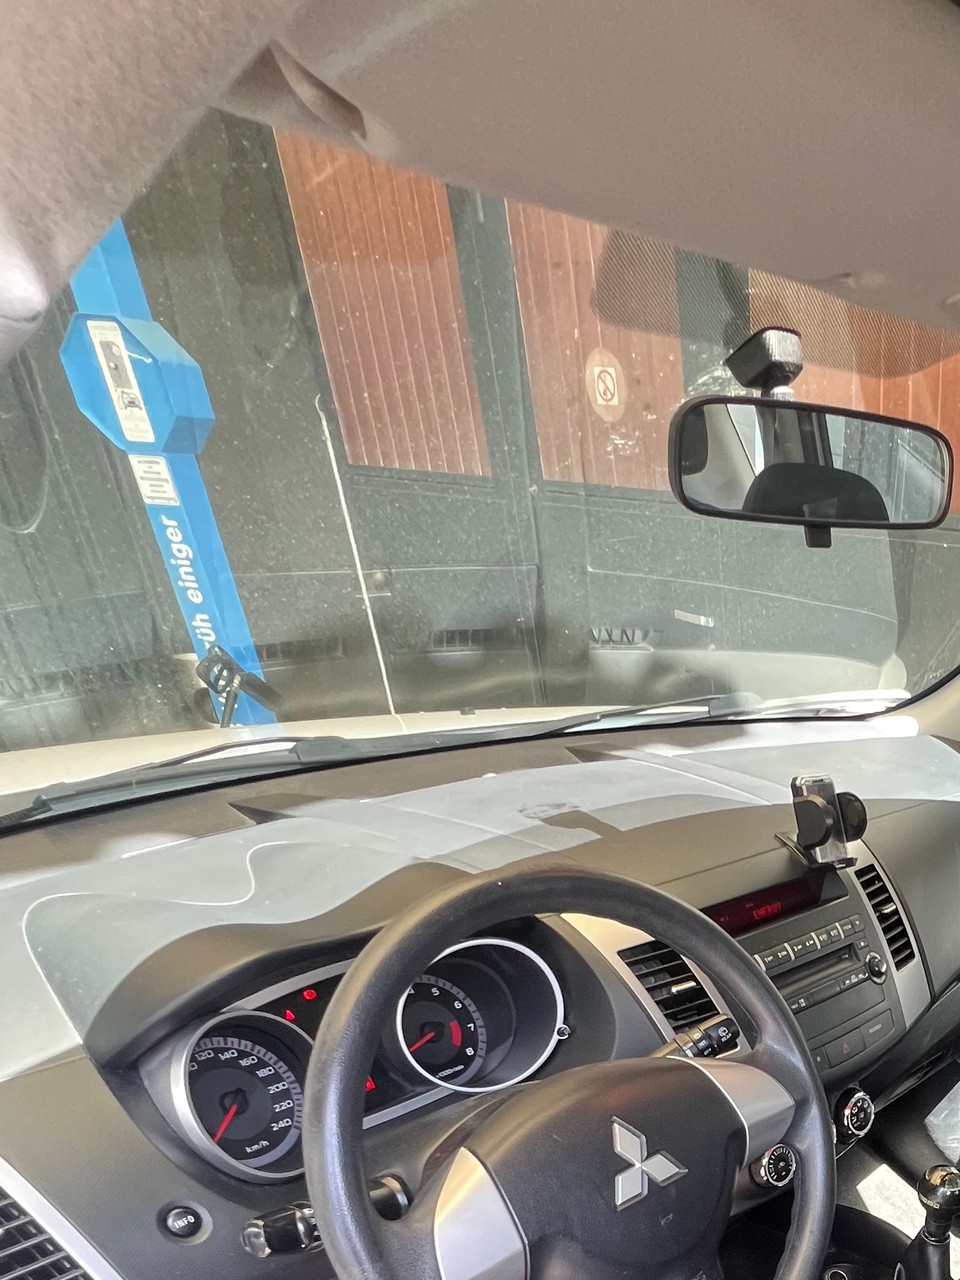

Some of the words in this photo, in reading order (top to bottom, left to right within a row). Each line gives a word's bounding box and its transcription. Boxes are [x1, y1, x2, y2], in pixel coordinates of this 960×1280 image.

[161, 514, 203, 604] einiger
[192, 613, 216, 649] üh
[431, 987, 440, 996] 5
[453, 1000, 462, 1009] 6
[467, 1023, 475, 1031] 7
[195, 1050, 215, 1061] 120
[218, 1049, 238, 1061] 140
[465, 1047, 475, 1056] 8
[238, 1055, 258, 1067] 160
[255, 1066, 275, 1078] 180
[267, 1081, 289, 1094] 200
[273, 1100, 294, 1112] 220
[271, 1118, 293, 1131] 240
[245, 1140, 270, 1153] km/h
[173, 1215, 196, 1229] INFO
